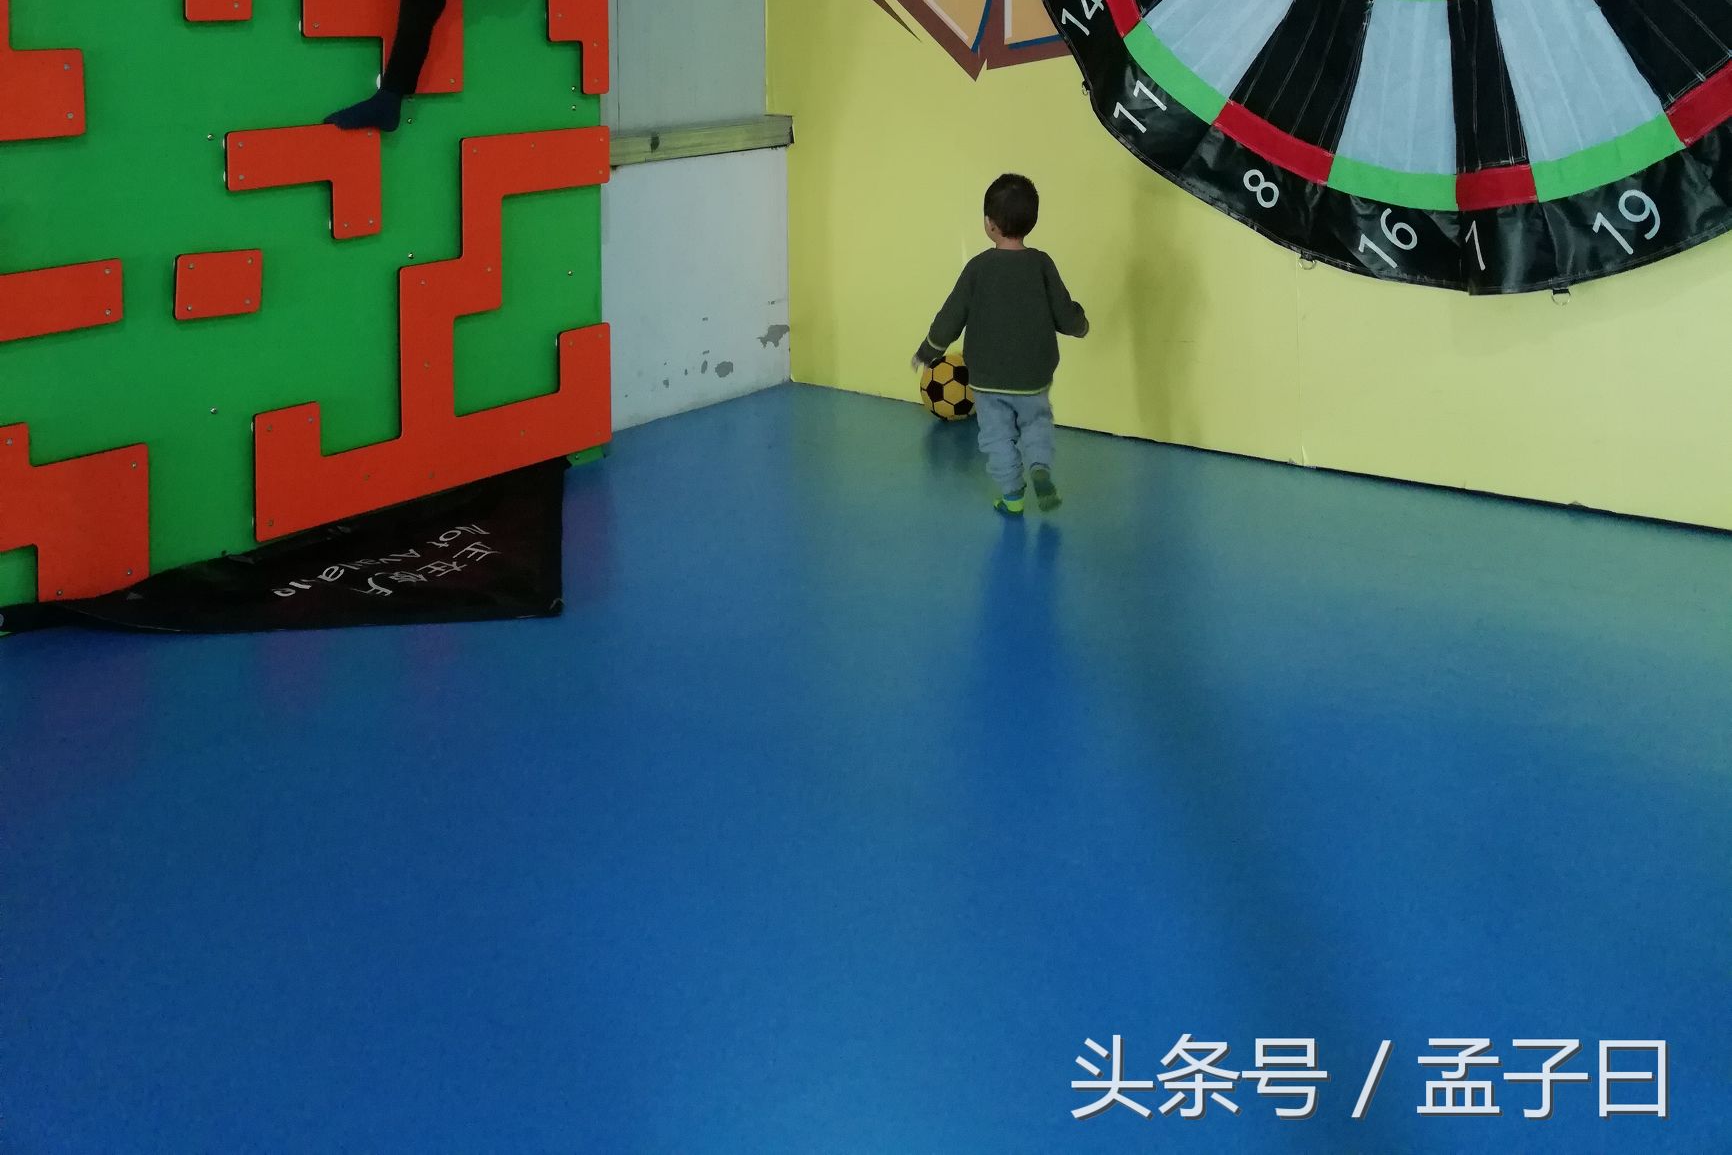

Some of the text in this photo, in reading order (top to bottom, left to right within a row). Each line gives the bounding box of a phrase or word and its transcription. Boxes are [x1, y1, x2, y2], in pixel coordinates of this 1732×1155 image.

[1113, 78, 1168, 134] 11
[1243, 169, 1280, 209] 8
[1358, 207, 1418, 269] 16
[1591, 188, 1661, 255] 19
